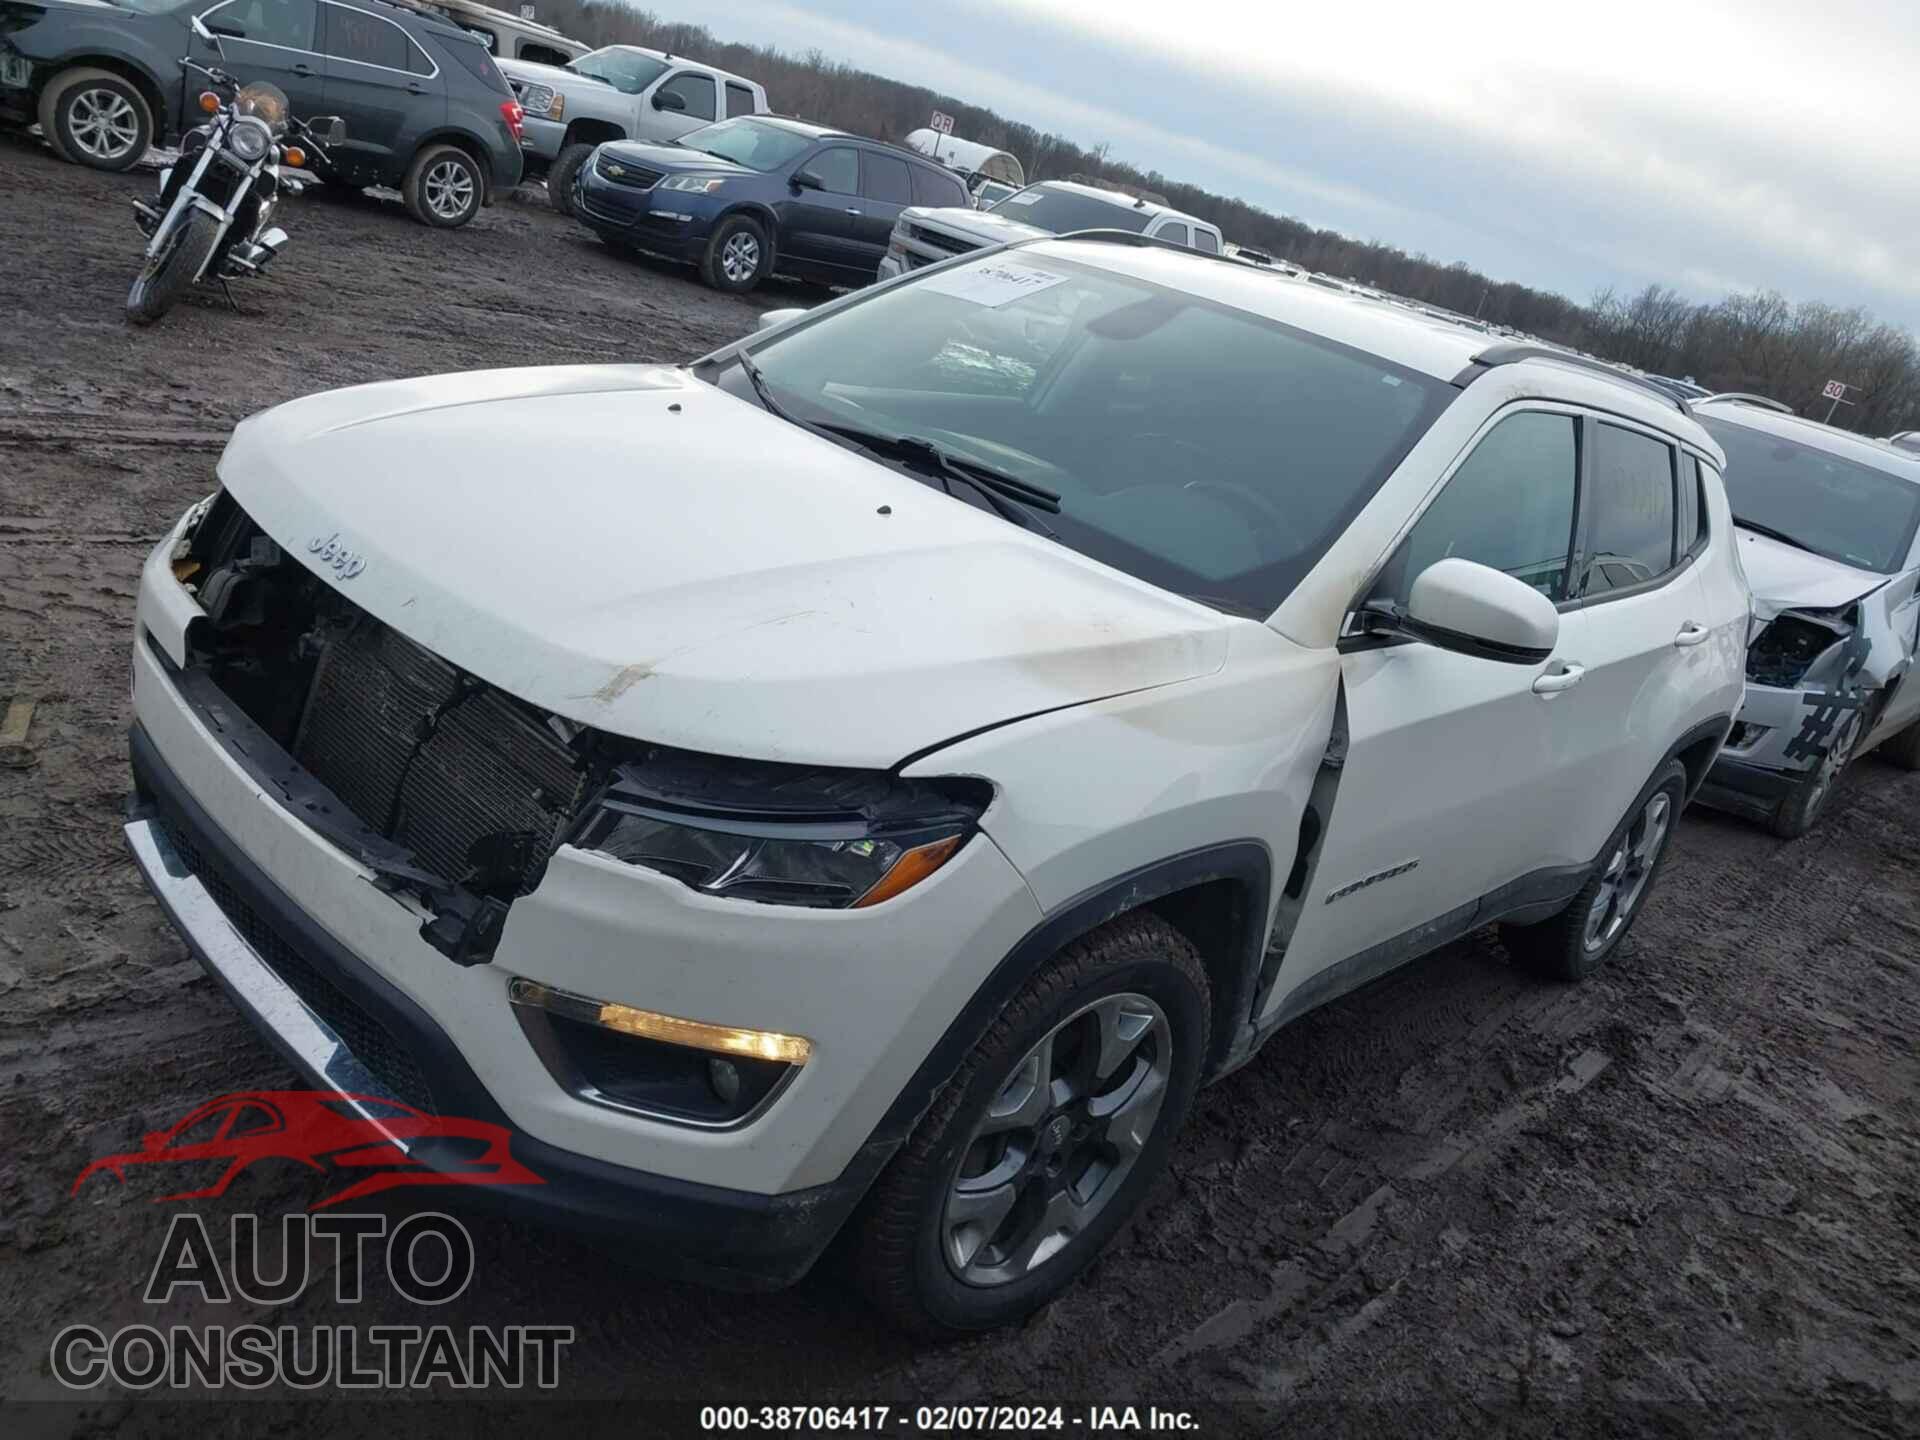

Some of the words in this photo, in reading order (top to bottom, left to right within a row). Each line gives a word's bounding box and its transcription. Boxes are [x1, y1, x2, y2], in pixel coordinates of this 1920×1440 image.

[933, 113, 951, 133] QR
[1825, 382, 1842, 397] 30
[308, 533, 367, 580] Jeep
